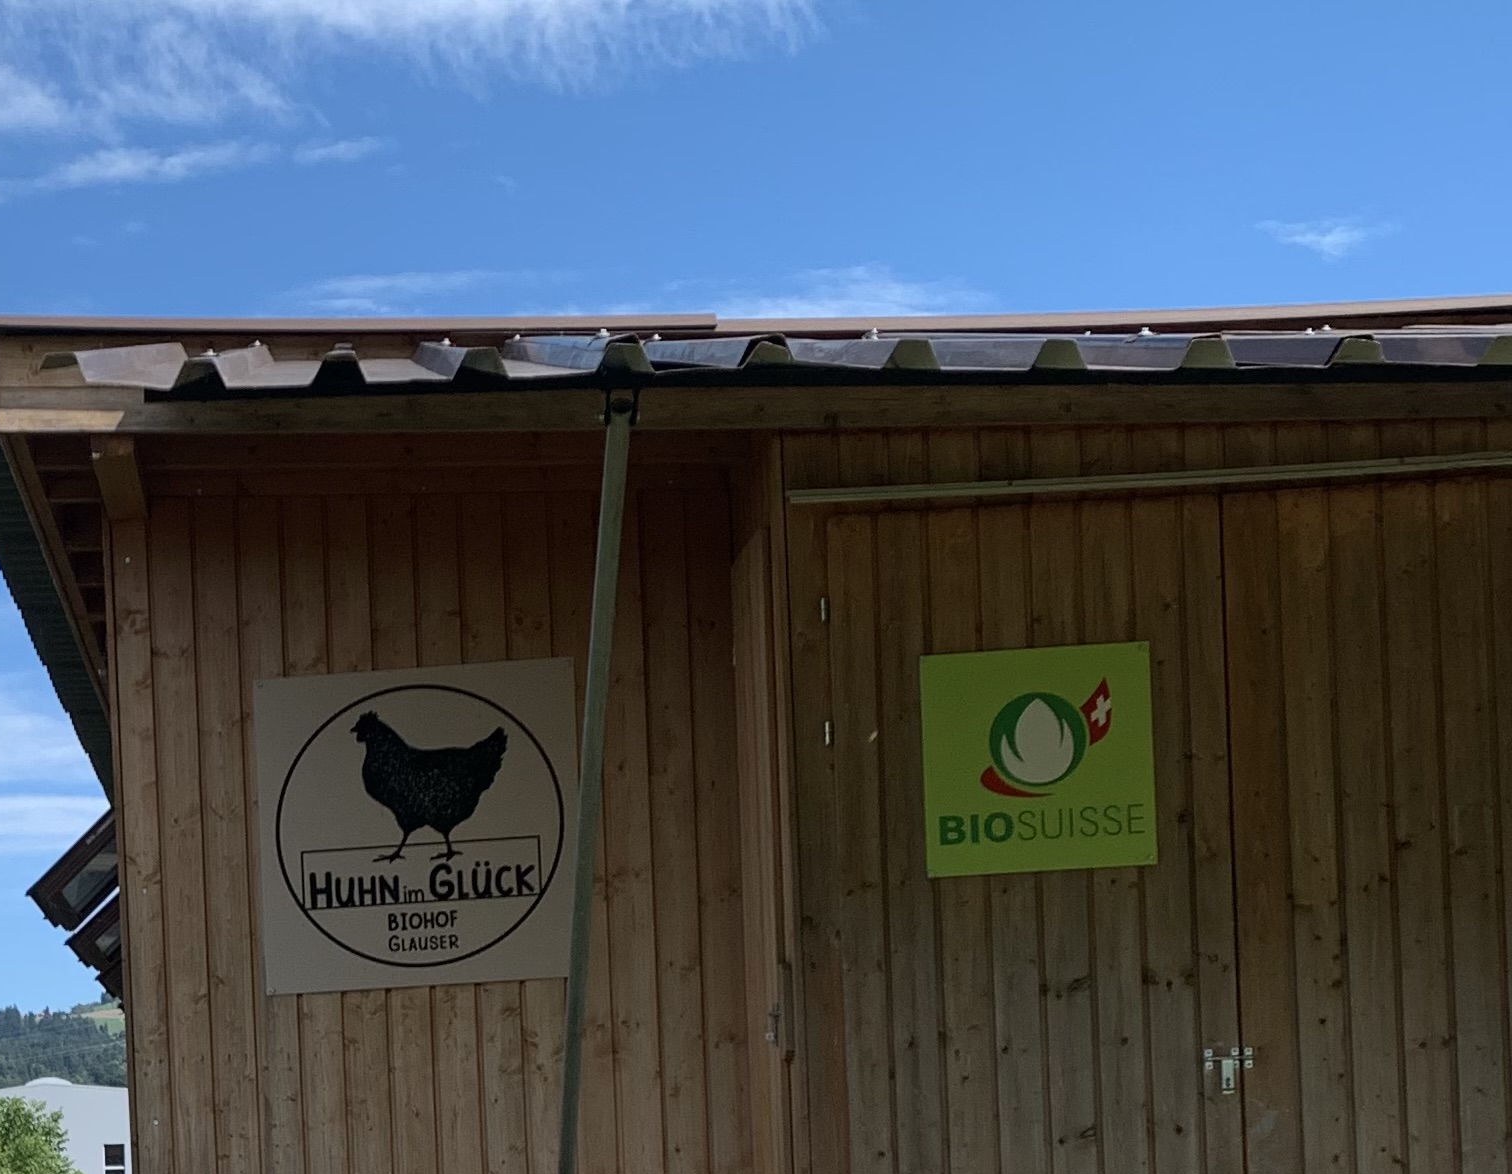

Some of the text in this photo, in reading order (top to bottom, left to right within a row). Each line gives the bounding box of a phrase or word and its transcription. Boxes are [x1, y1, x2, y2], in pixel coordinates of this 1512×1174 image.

[309, 861, 535, 909] HUHN im GLÜCK
[388, 910, 458, 931] BIOHOF
[388, 934, 460, 952] GLAUSER
